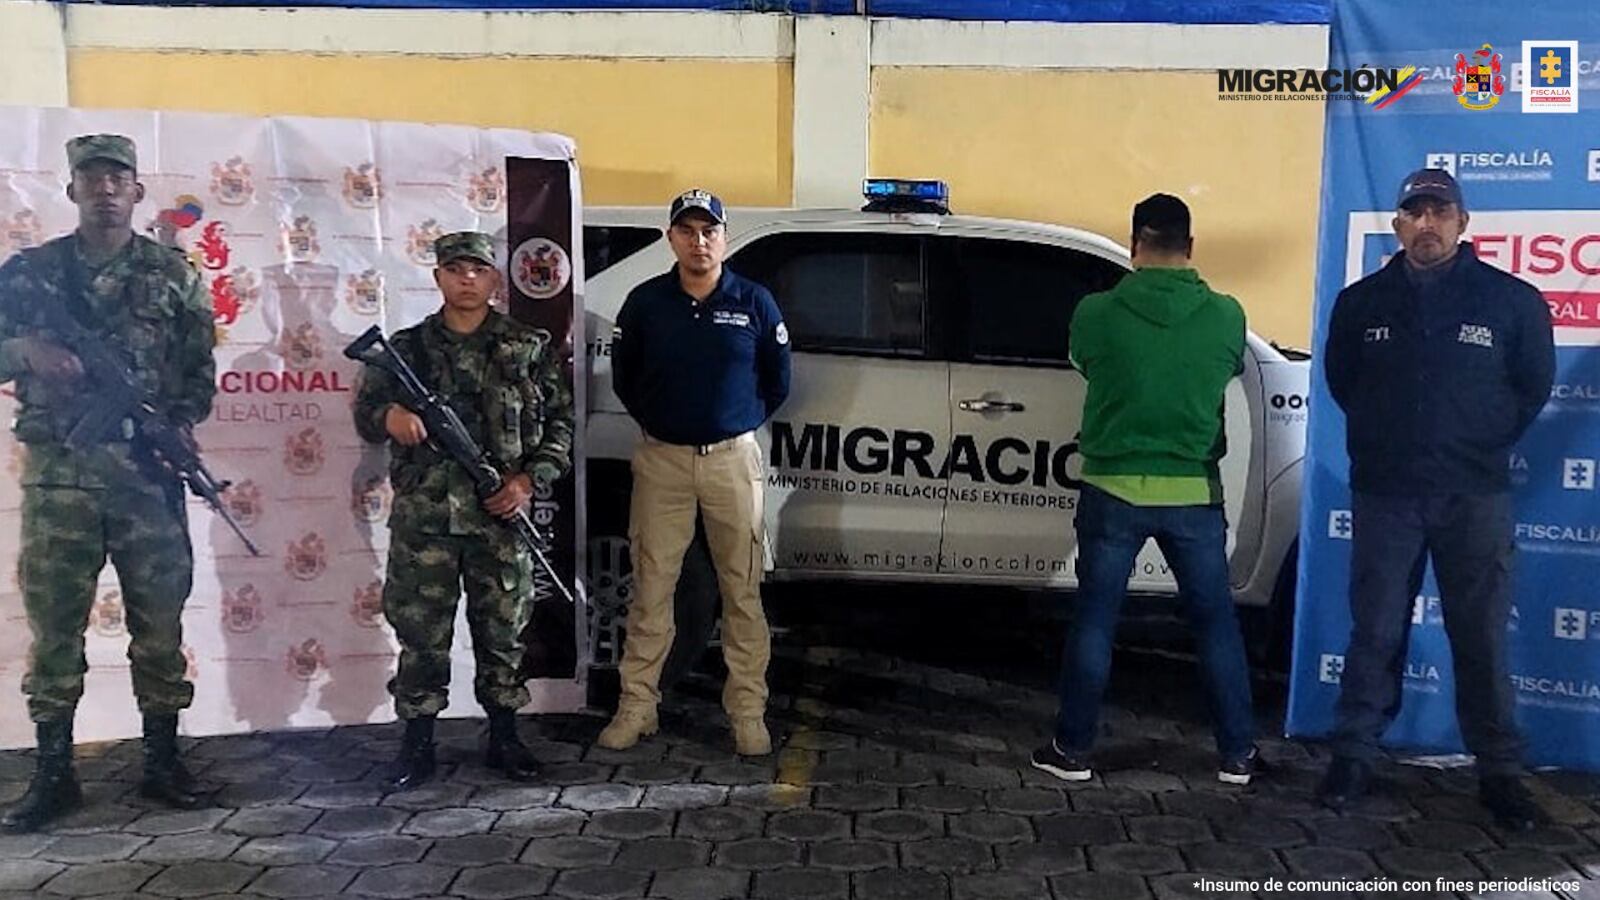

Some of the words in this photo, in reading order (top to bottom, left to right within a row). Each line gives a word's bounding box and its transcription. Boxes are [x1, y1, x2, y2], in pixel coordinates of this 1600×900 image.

[1460, 149, 1553, 167] FISCALÍA
[221, 371, 349, 393] CIONAL
[215, 402, 323, 422] LEALTAD
[768, 474, 856, 493] MINISTERIO
[860, 480, 881, 494] DE
[884, 483, 978, 502] RELACIONES
[983, 490, 1076, 510] EXTERIORES
